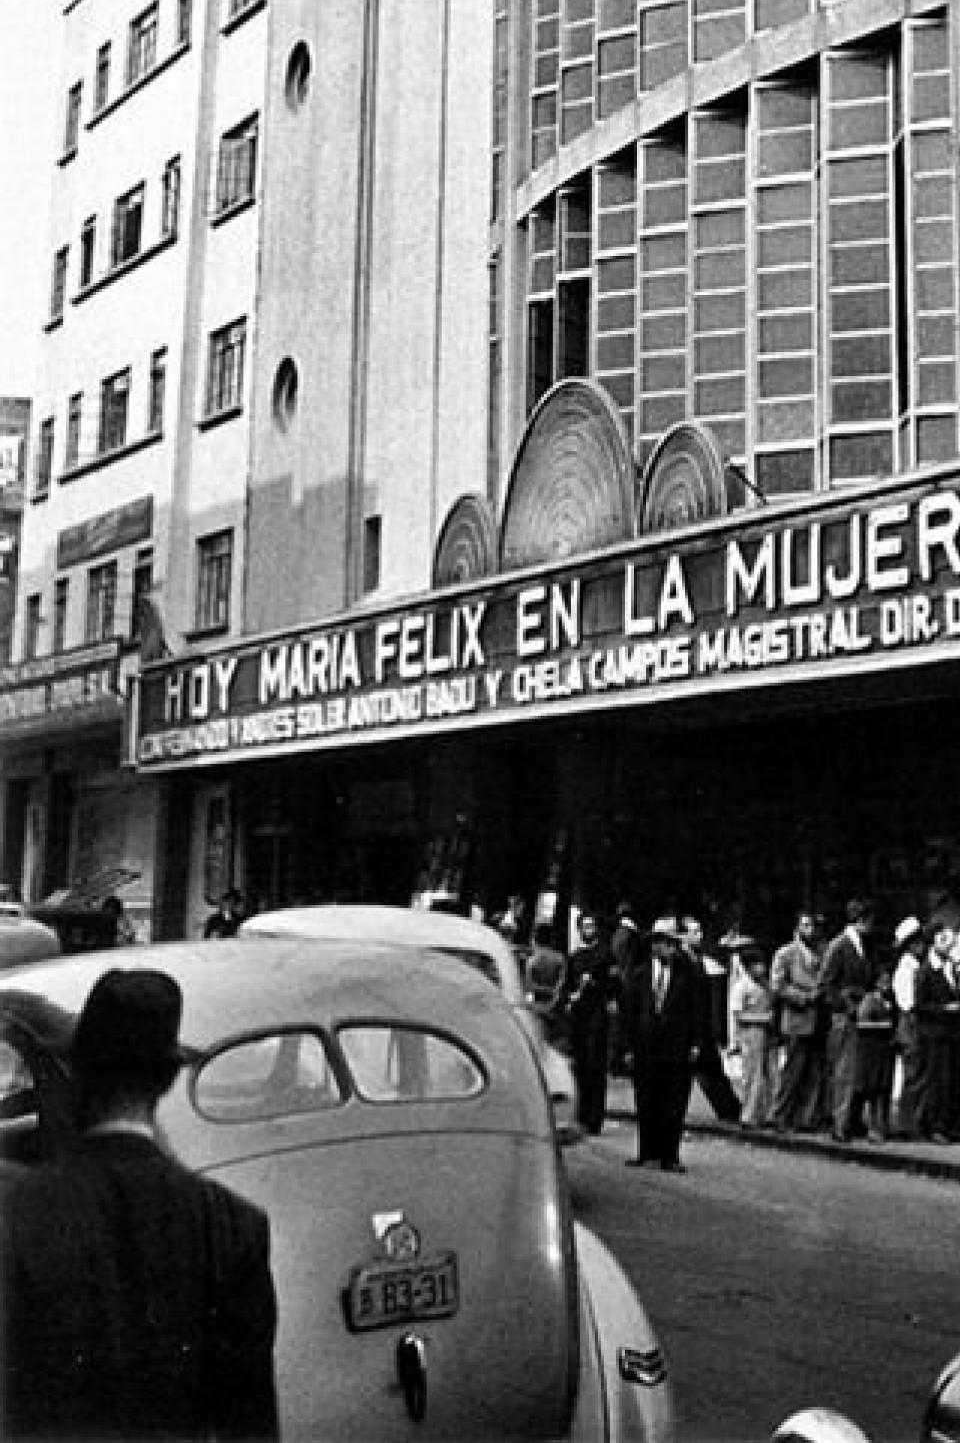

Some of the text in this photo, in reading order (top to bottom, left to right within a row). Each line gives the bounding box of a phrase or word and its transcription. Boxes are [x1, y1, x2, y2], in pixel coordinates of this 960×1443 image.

[164, 658, 239, 722] HOY
[259, 630, 362, 705] MARIA
[375, 601, 486, 684] FELIX
[516, 577, 581, 656] EN
[624, 555, 695, 636] LA
[484, 669, 502, 708] Y
[512, 655, 584, 703] CHELA
[587, 637, 691, 690] CAMPOS
[698, 604, 871, 673] MAGISTRAL
[879, 594, 939, 646] DIR.
